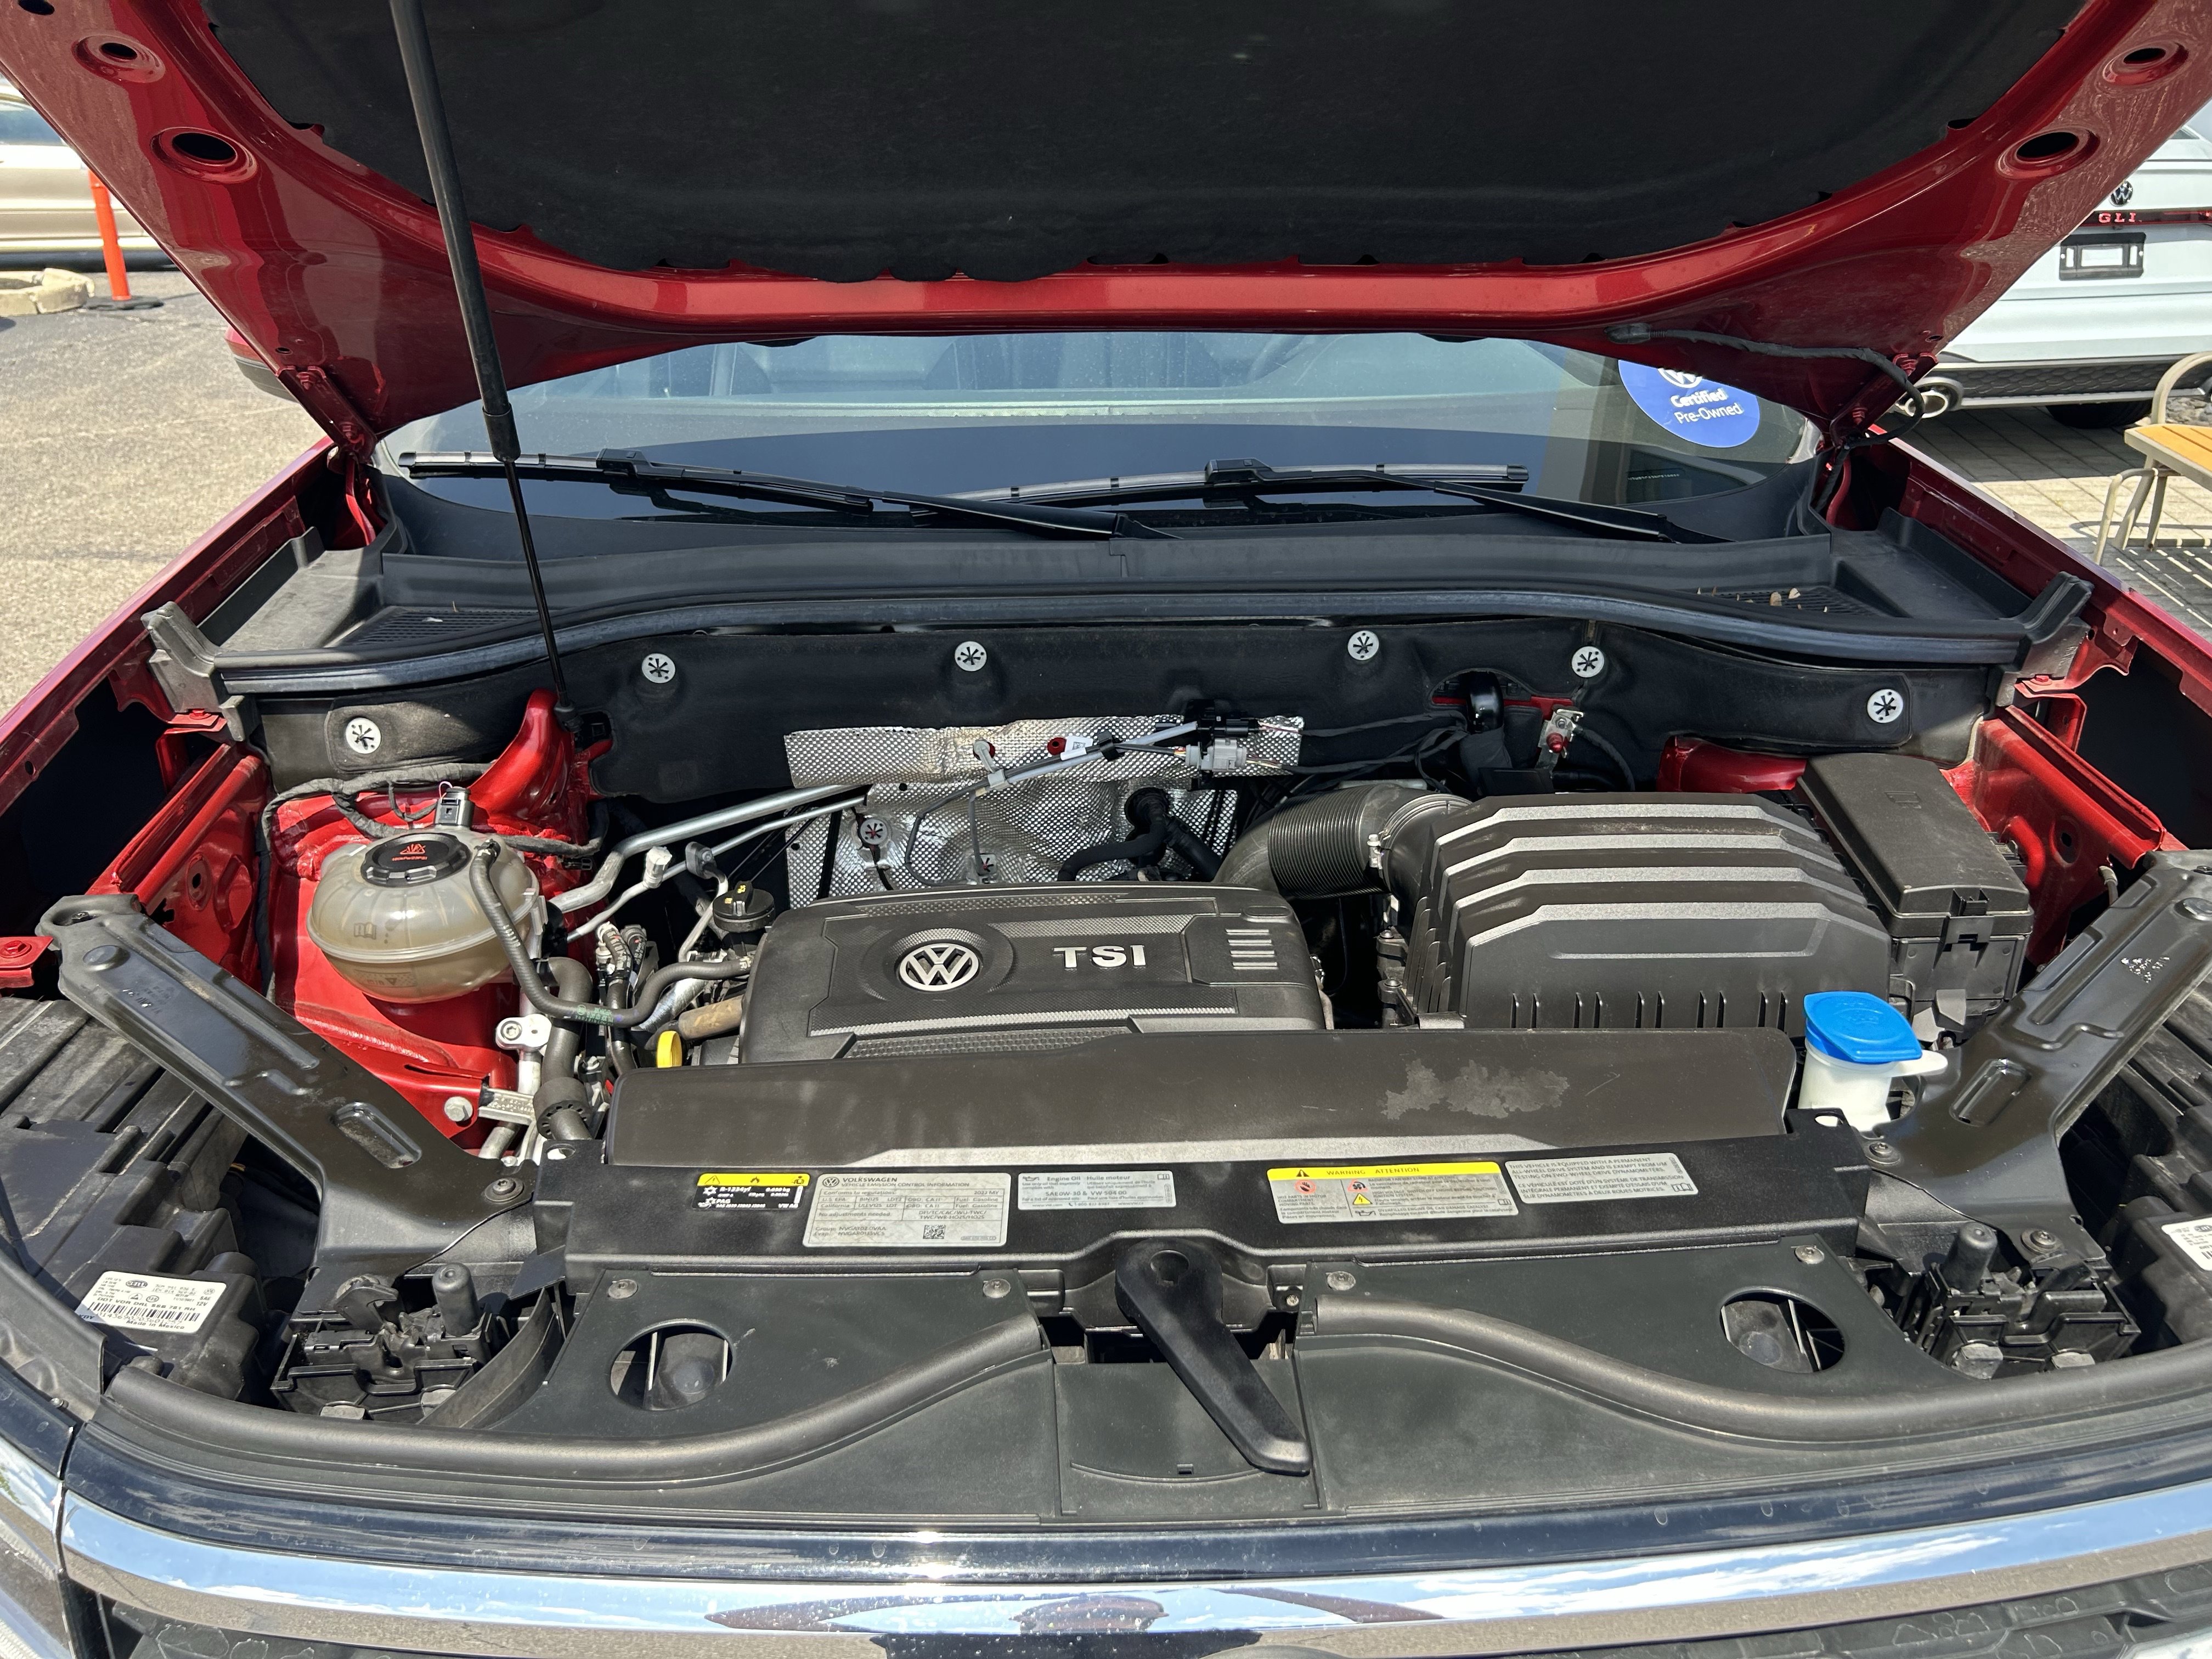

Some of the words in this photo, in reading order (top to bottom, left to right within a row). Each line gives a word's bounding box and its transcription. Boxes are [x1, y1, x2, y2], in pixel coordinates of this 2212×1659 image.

[2098, 212, 2136, 223] GLI
[1671, 388, 1728, 408] Certified
[1674, 403, 1743, 424] Pre-Owned
[1052, 944, 1147, 971] TSI
